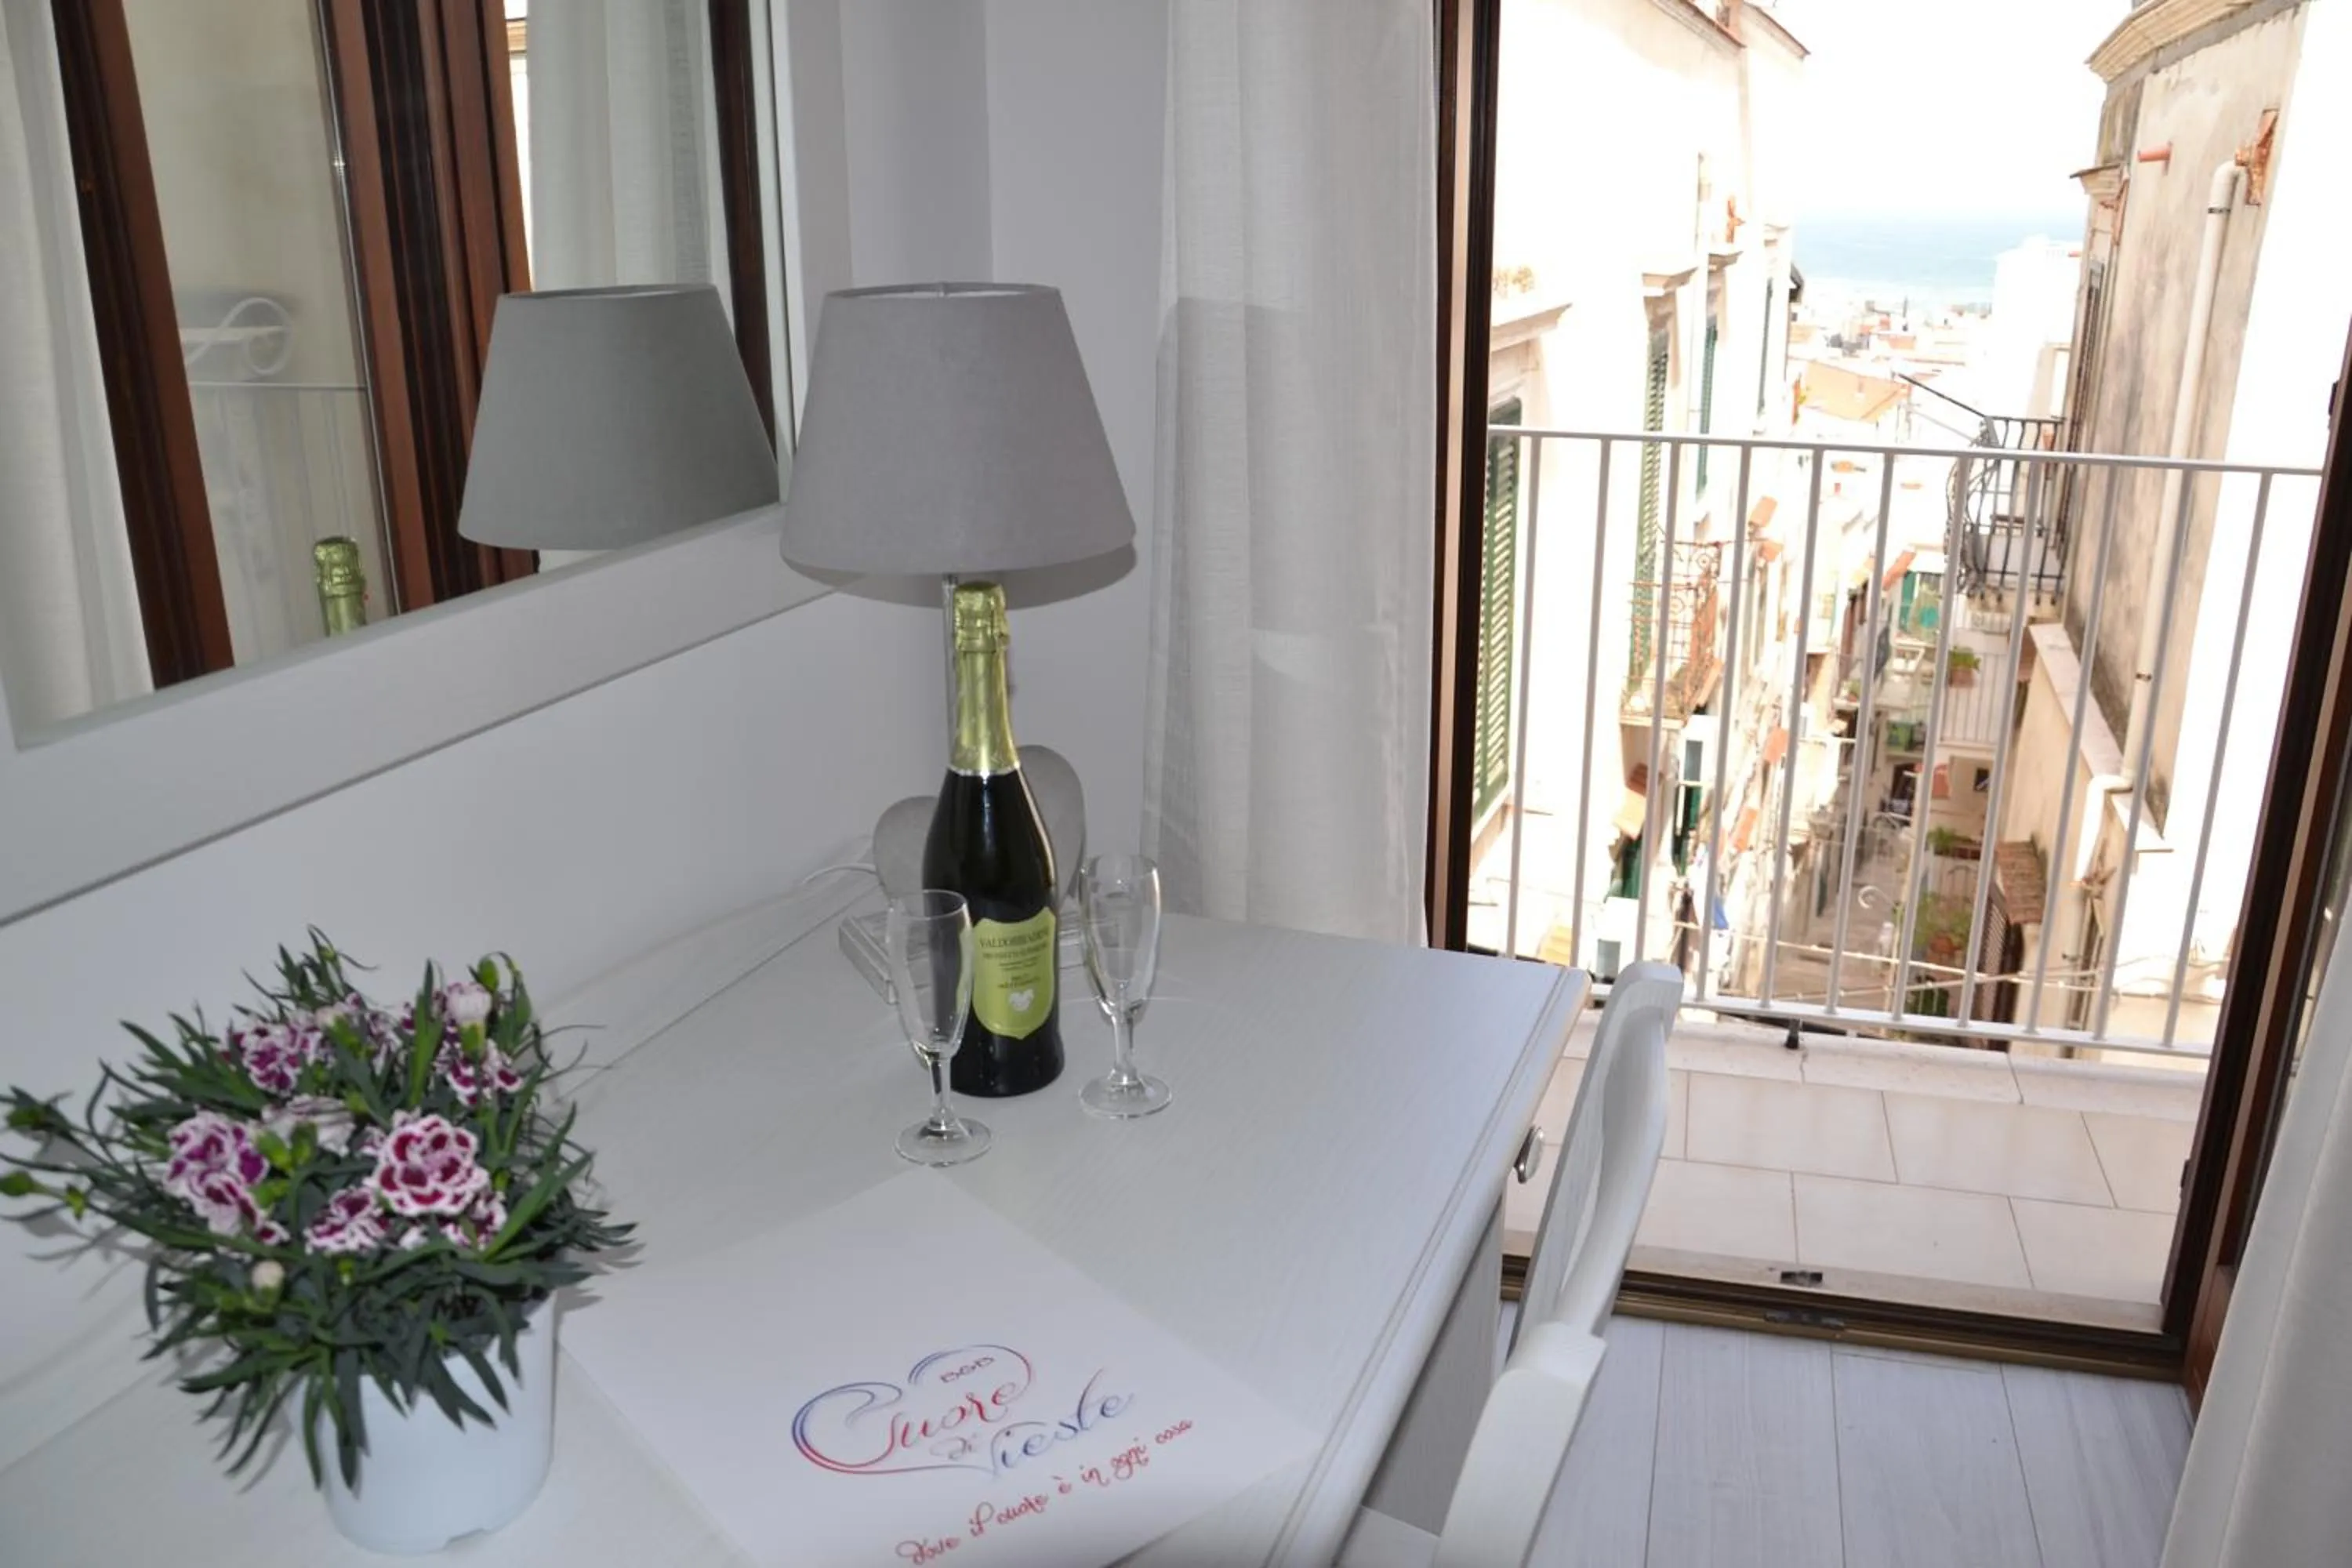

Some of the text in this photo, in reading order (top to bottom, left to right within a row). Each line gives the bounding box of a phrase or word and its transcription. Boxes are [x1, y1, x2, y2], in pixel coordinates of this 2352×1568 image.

[792, 1380, 1021, 1473] Cuore
[996, 1494, 1050, 1525] cuore
[1079, 1464, 1111, 1487] in
